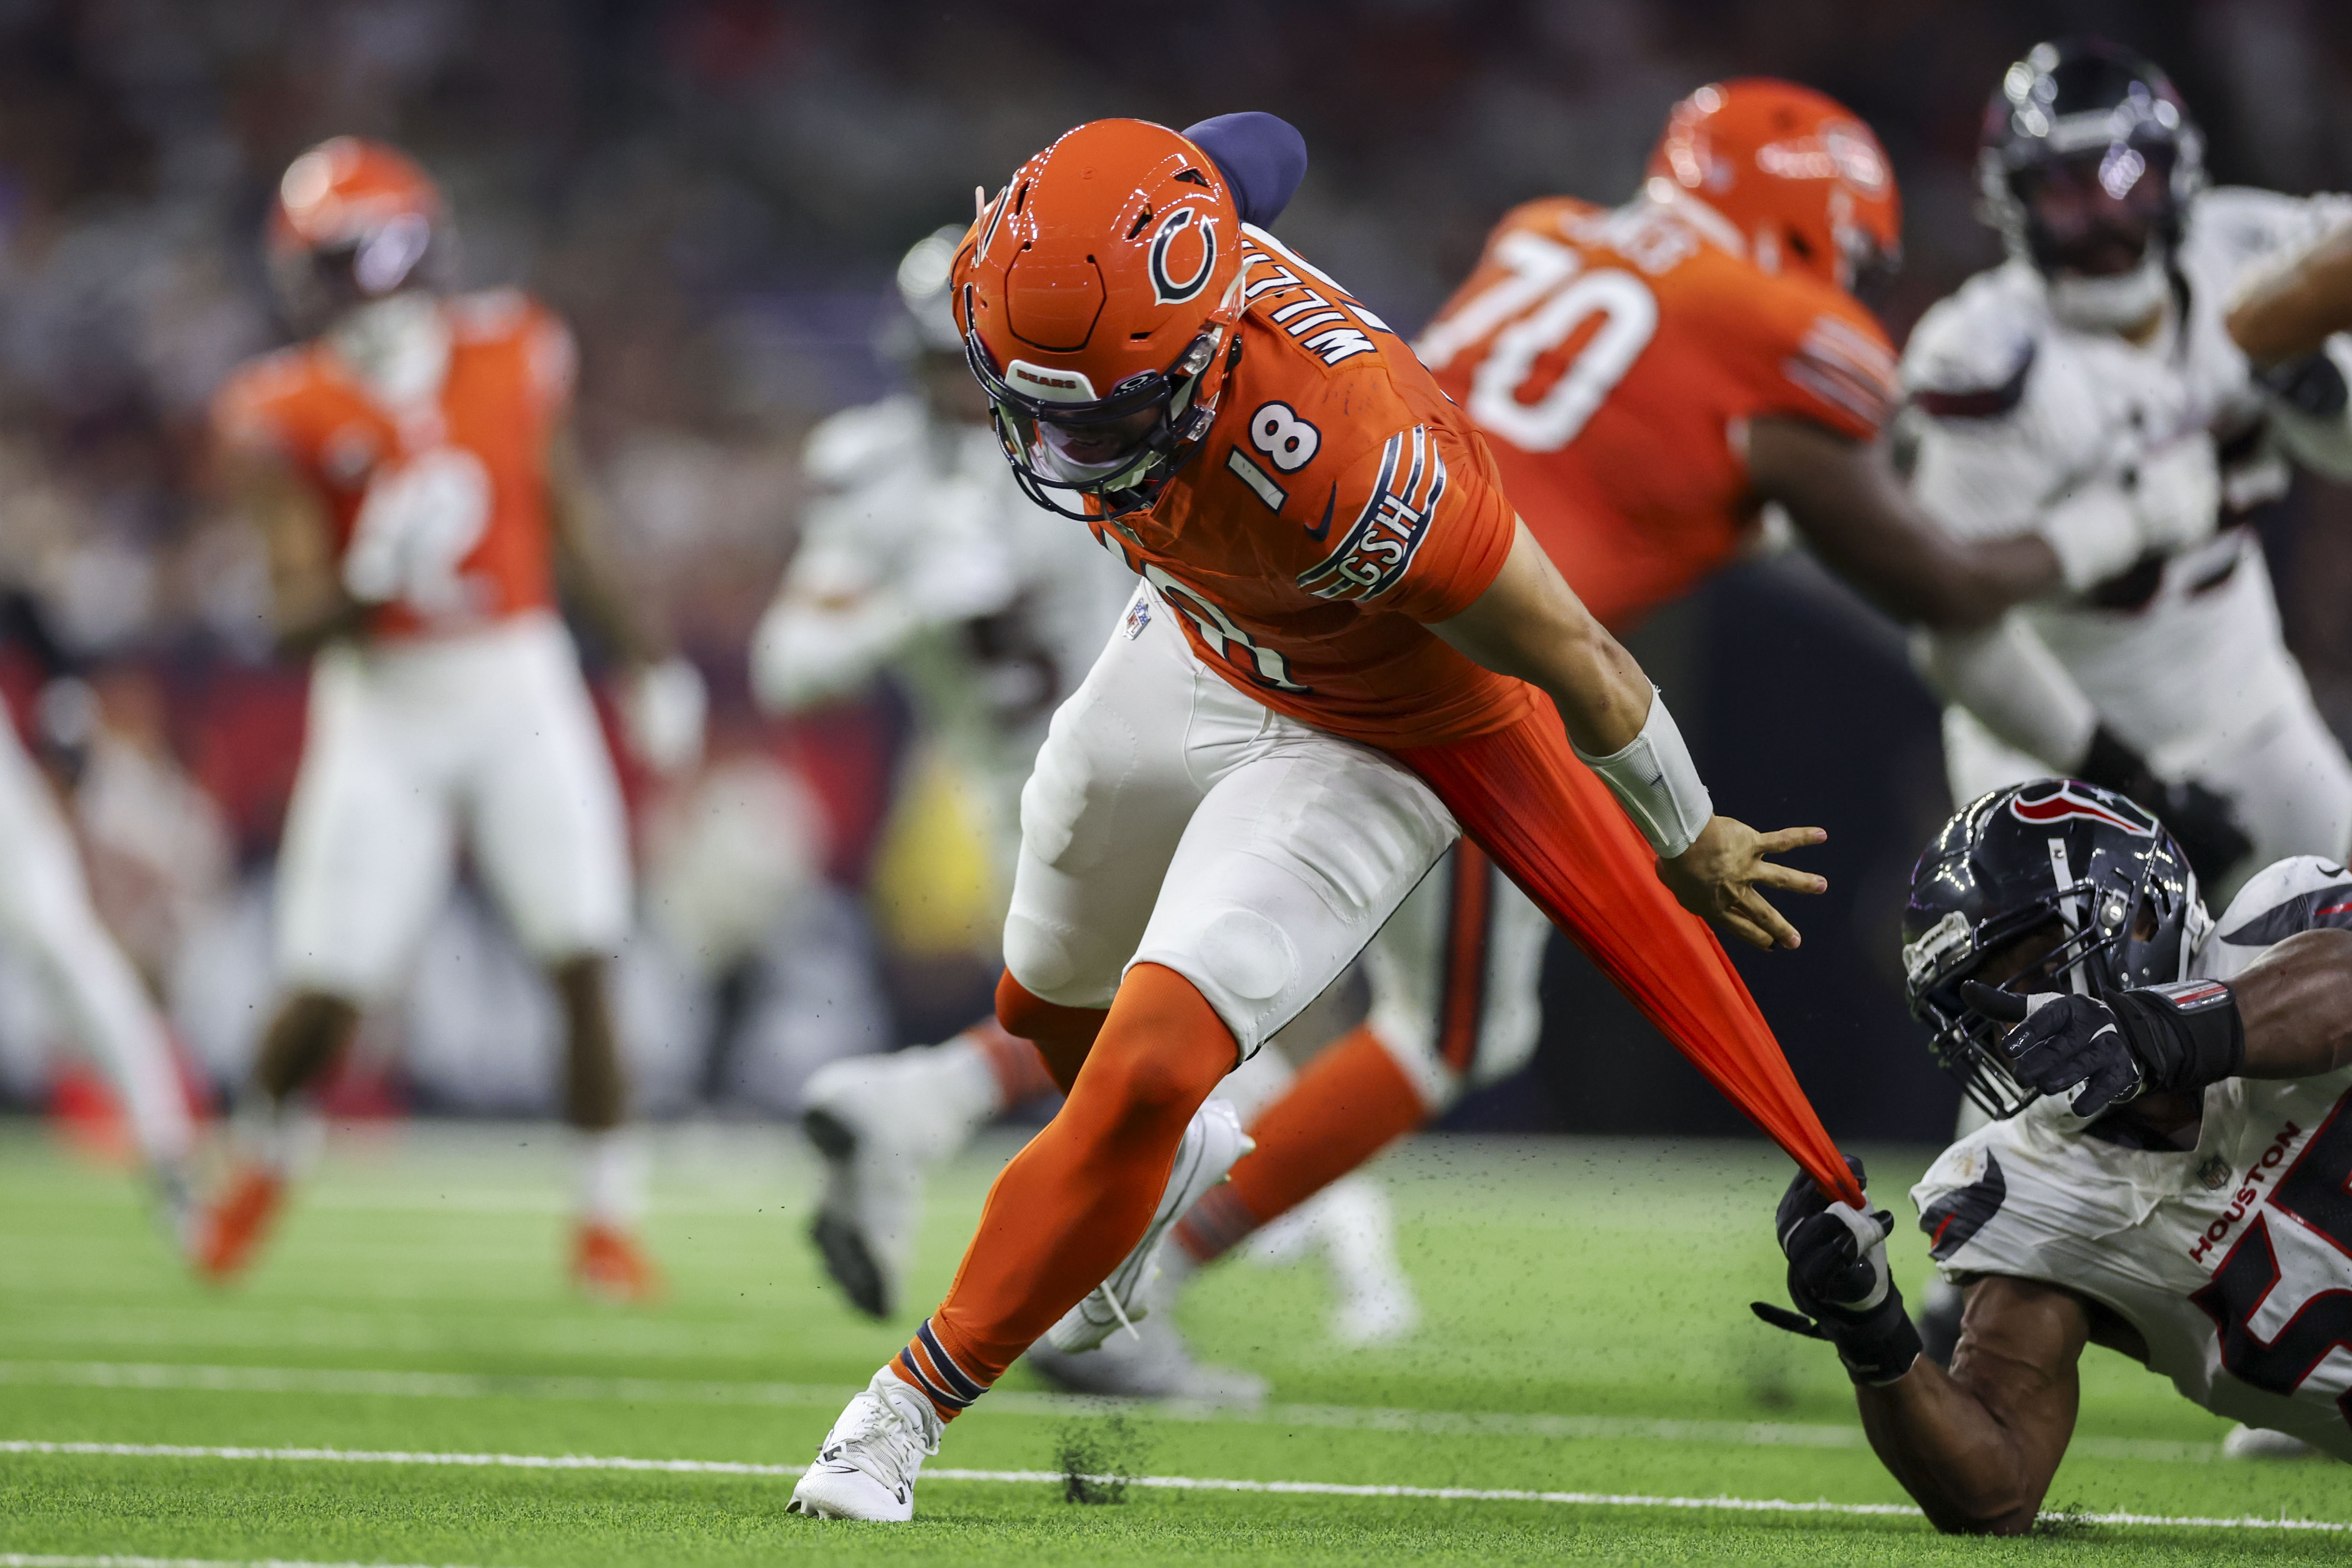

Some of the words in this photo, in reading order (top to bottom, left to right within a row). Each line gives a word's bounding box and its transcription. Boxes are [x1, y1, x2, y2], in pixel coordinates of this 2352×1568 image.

[1241, 240, 1378, 367] WILL
[1407, 230, 1659, 453] 70
[1017, 369, 1077, 389] BEARS
[1224, 400, 1321, 517] 18
[1338, 494, 1421, 587] GSH
[2189, 1120, 2302, 1264] HOUSTON
